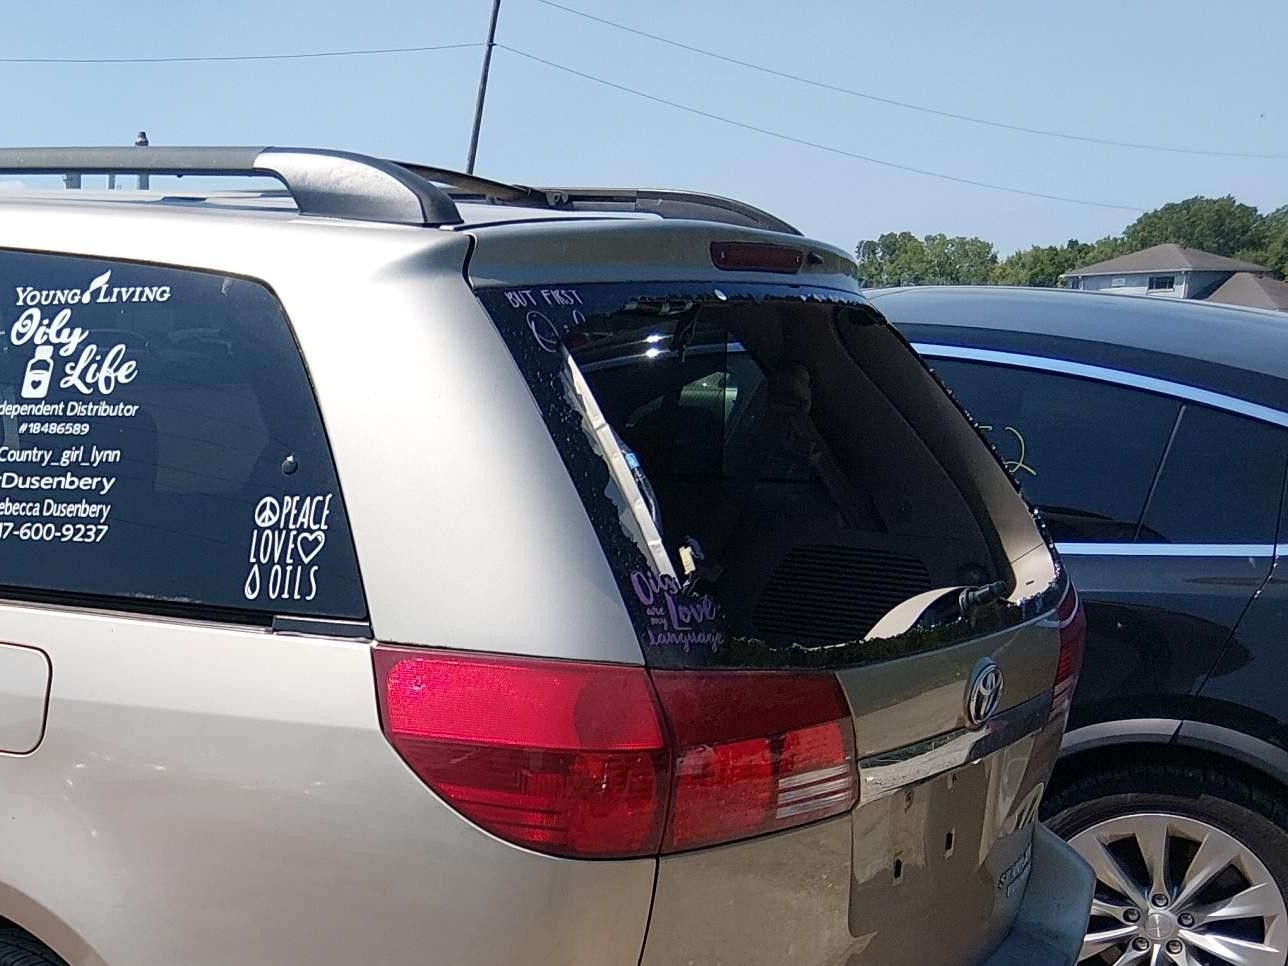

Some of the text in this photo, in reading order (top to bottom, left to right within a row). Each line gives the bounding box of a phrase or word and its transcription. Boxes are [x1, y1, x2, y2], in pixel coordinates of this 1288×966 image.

[15, 283, 172, 306] YOUNG LIVING
[503, 288, 584, 309] BUT FIRST
[10, 307, 89, 357] Oily
[59, 343, 139, 395] Life
[66, 400, 140, 418] Distributor
[18, 422, 90, 436] #18486589
[42, 498, 111, 523] Dusenbery
[279, 492, 333, 530] PEACE
[249, 529, 298, 564] LOVE
[268, 564, 319, 600] OILS
[663, 591, 717, 631] Love
